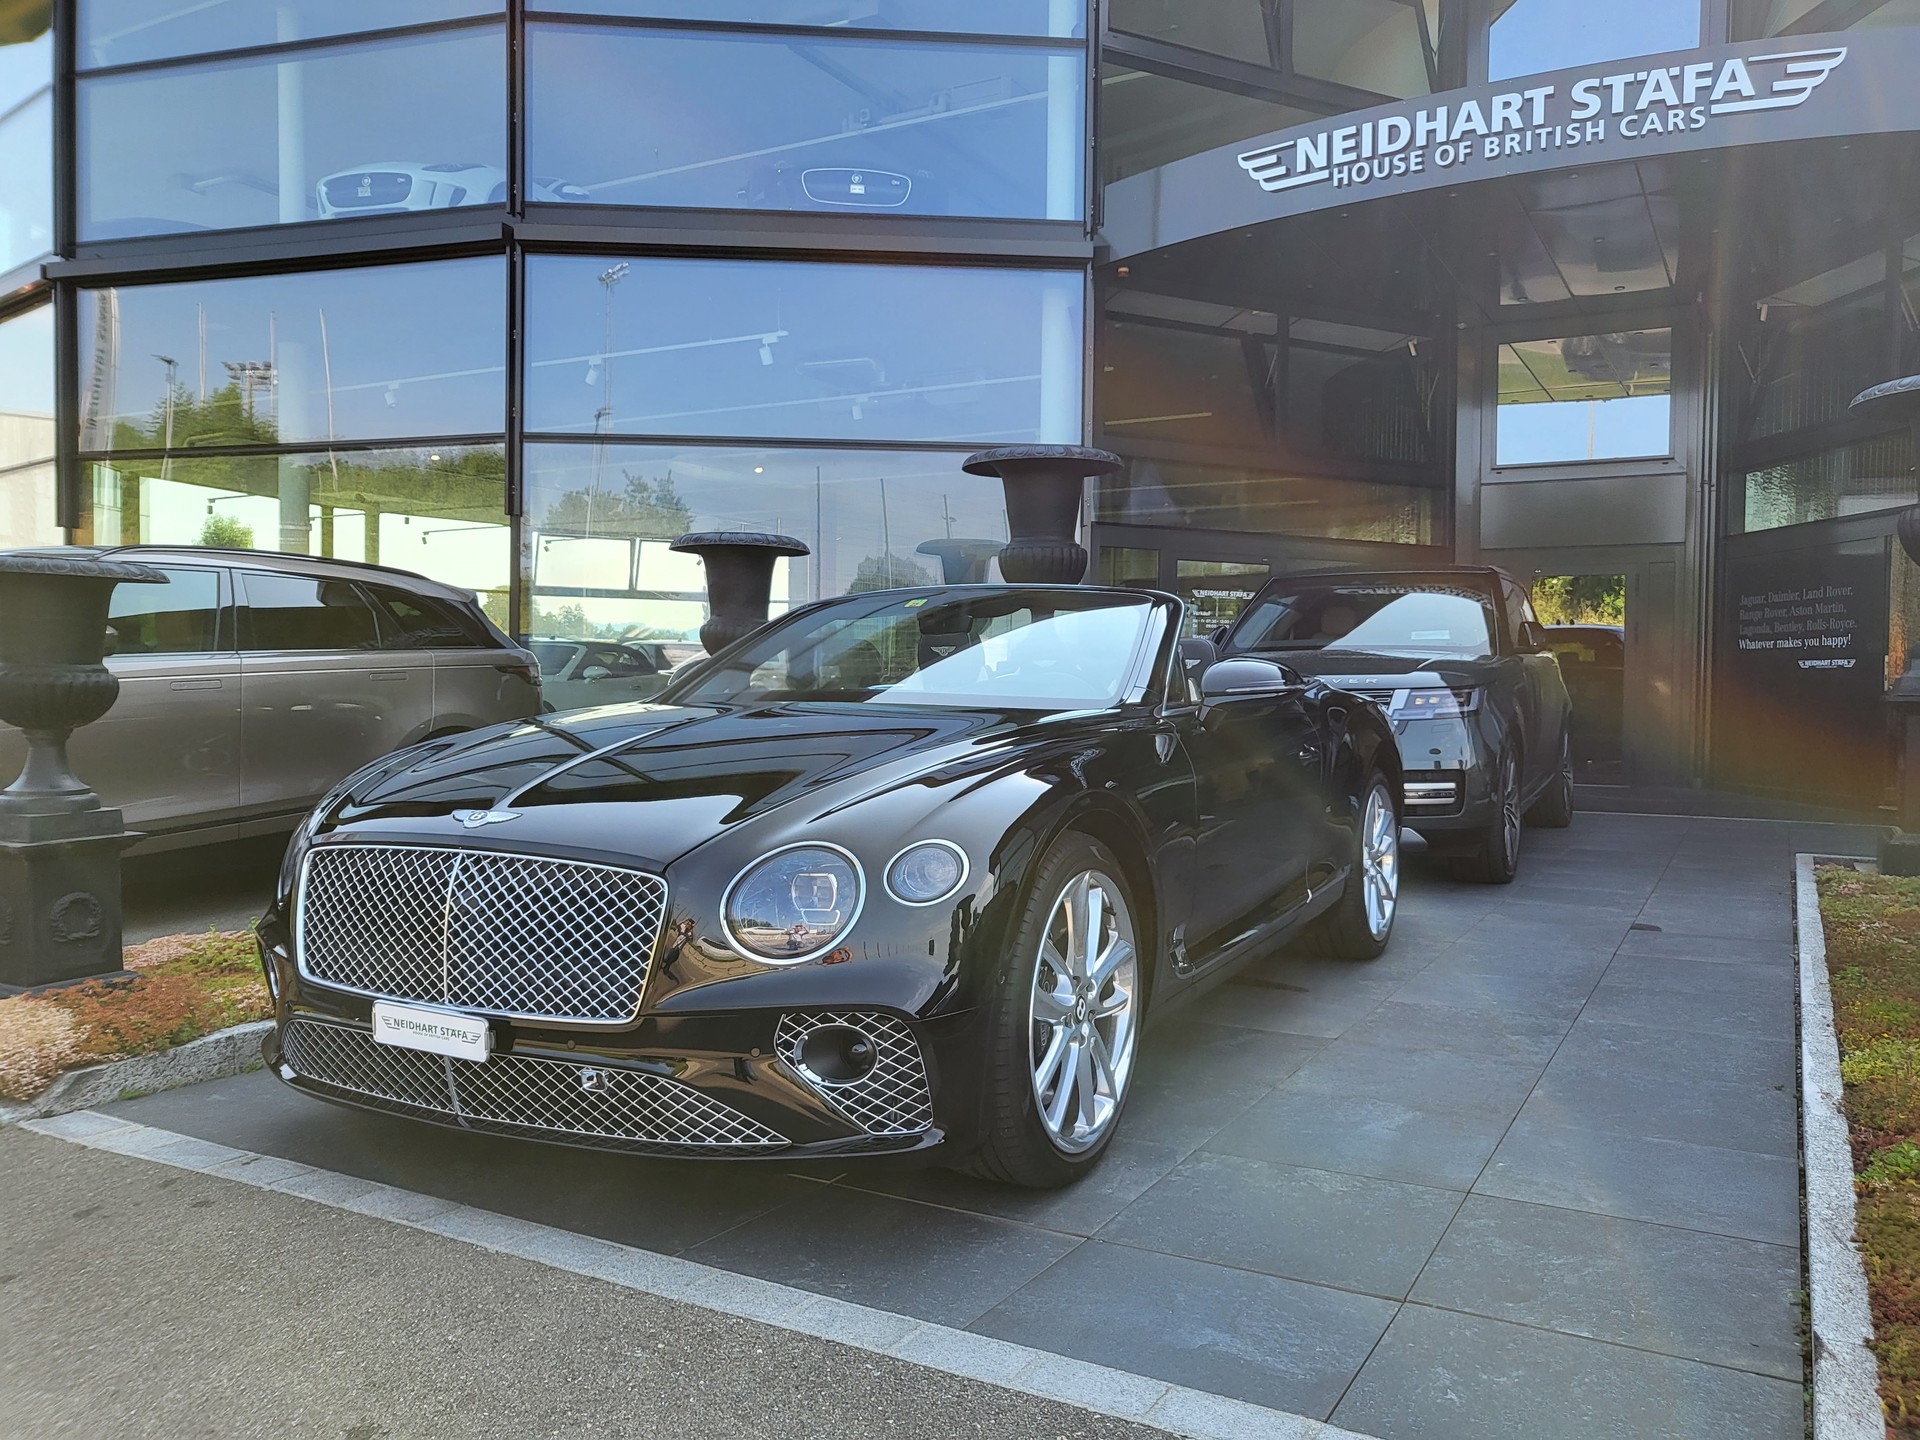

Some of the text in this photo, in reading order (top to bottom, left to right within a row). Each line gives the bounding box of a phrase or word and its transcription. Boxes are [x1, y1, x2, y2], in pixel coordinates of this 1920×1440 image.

[1296, 58, 1756, 173] NEIDHART STÄFA
[1333, 106, 1706, 187] HOUSE OF BRITISH CARS
[1739, 585, 1853, 607] Jaguar, Daimler, Land Rover,
[1739, 601, 1847, 622] Range Rover, Aston Martin,
[1774, 620, 1805, 634] Bentley,
[1738, 633, 1851, 650] Whatever makes you happy!
[393, 1018, 469, 1040] NEIDHART STÄFA
